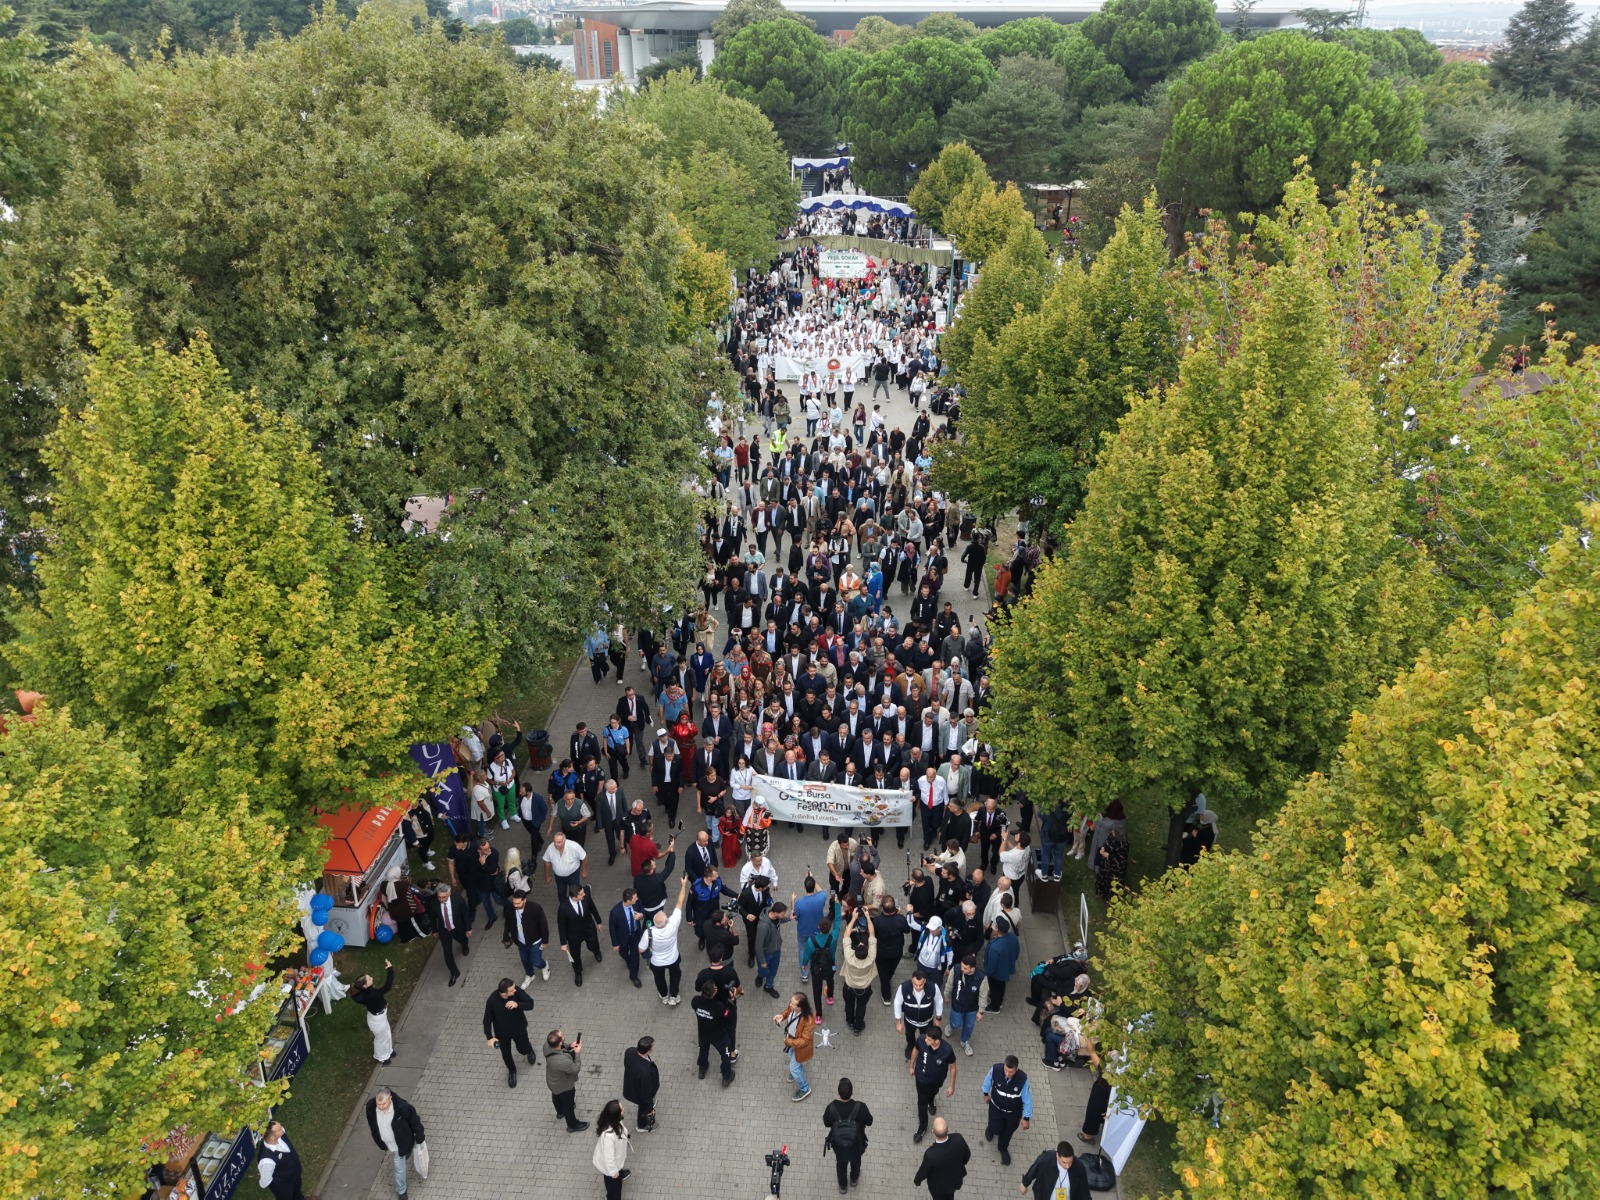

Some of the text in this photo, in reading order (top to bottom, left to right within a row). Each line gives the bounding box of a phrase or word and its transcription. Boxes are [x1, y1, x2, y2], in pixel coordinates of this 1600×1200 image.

[779, 791, 852, 811] Gonomi
[806, 790, 831, 799] Bursa
[214, 1146, 244, 1199] UZAY
